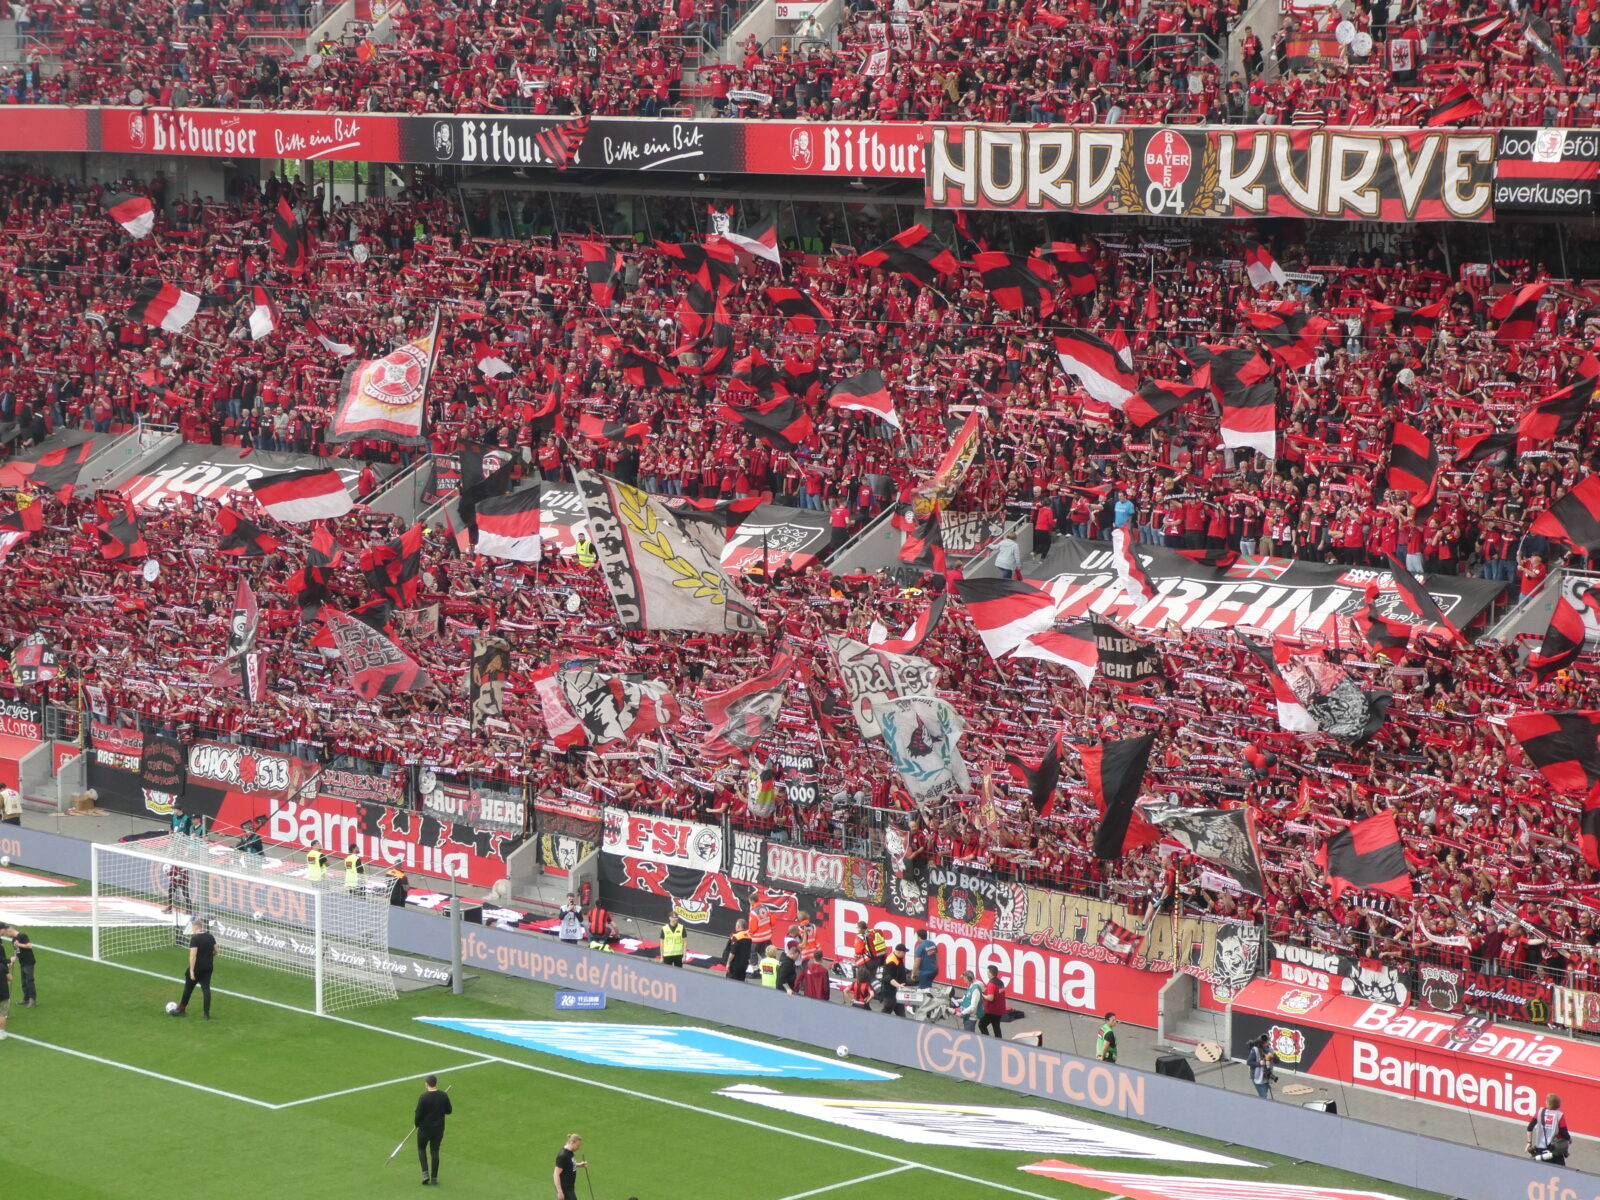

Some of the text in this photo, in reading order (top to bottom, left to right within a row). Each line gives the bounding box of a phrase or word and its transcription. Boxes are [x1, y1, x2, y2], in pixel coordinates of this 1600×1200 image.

[777, 6, 788, 17] D9
[152, 112, 257, 155] Bitburger
[274, 117, 361, 155] Bitte ein Bit
[603, 124, 704, 165] Bitte ein Bit
[930, 127, 1496, 218] NORD KURVE
[1146, 153, 1189, 166] BAYER
[1163, 131, 1174, 188] BAYER
[1145, 181, 1186, 215] 04
[190, 744, 239, 781] CHAOS
[258, 755, 290, 790] 513
[626, 816, 692, 858] FSI
[734, 832, 763, 853] WEST
[731, 866, 759, 884] BOYZ
[733, 850, 761, 869] SIDE
[208, 872, 309, 924] DITCON
[959, 874, 998, 899] BOYZ
[225, 926, 248, 940] trive
[262, 934, 286, 949] trive
[339, 952, 366, 966] trive
[380, 960, 408, 974] trive
[834, 897, 1097, 1011] Barmenia
[1272, 942, 1341, 975] YOUNG
[423, 968, 449, 982] trive
[1280, 963, 1331, 991] BOYS
[1464, 983, 1528, 1006] Leverkusen
[1554, 986, 1585, 1028] LEV
[1001, 1045, 1145, 1116] DITCON
[1352, 1039, 1538, 1118] Barmenia
